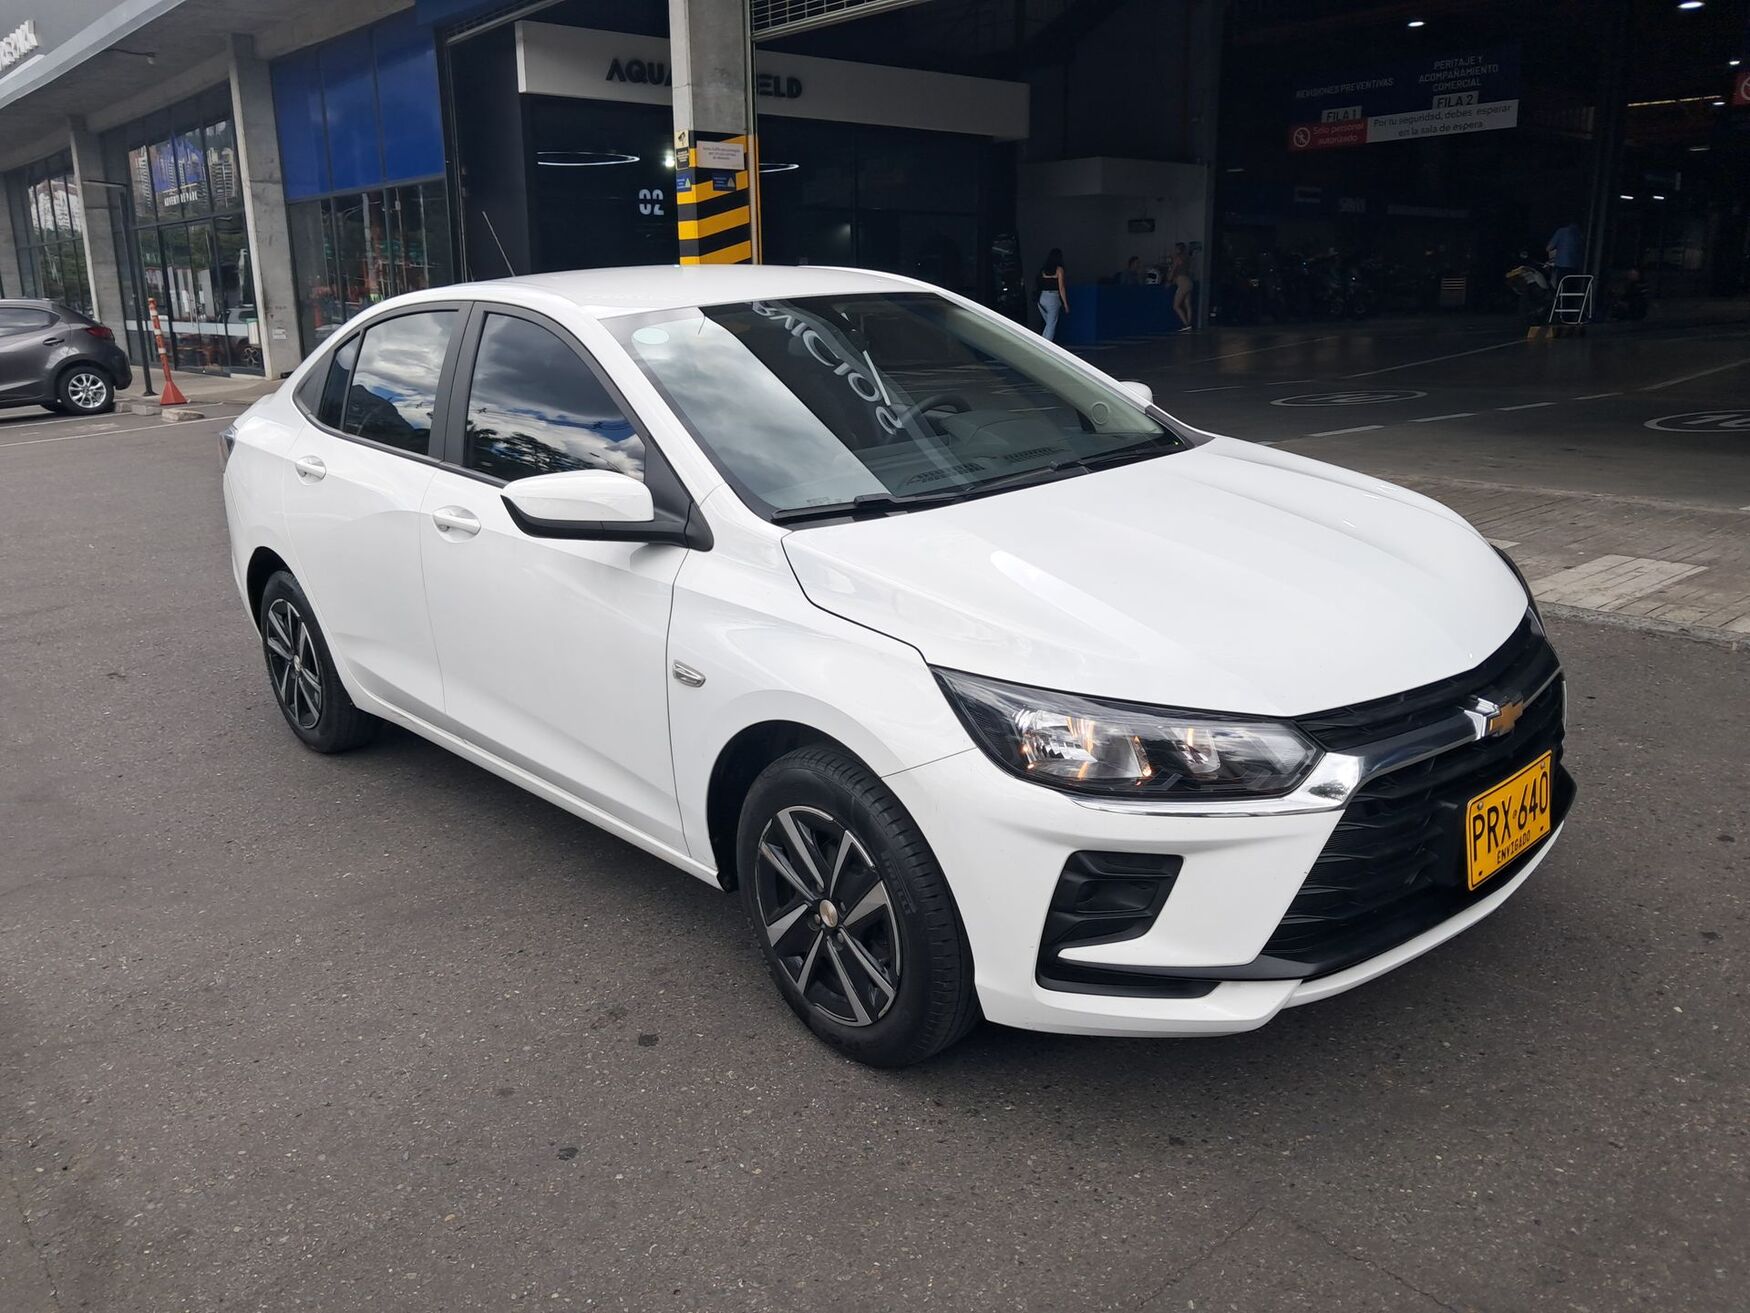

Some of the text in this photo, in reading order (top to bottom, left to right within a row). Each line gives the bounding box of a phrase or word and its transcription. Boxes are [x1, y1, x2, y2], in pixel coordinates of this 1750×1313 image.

[757, 74, 803, 99] ELD
[1433, 78, 1482, 91] COMERCIAL
[1437, 94, 1474, 108] FILA 2
[1326, 110, 1349, 121] FILA
[1476, 105, 1512, 117] esperar
[1439, 123, 1451, 133] de
[638, 188, 665, 216] 02
[1496, 829, 1531, 865] ENVIGADO
